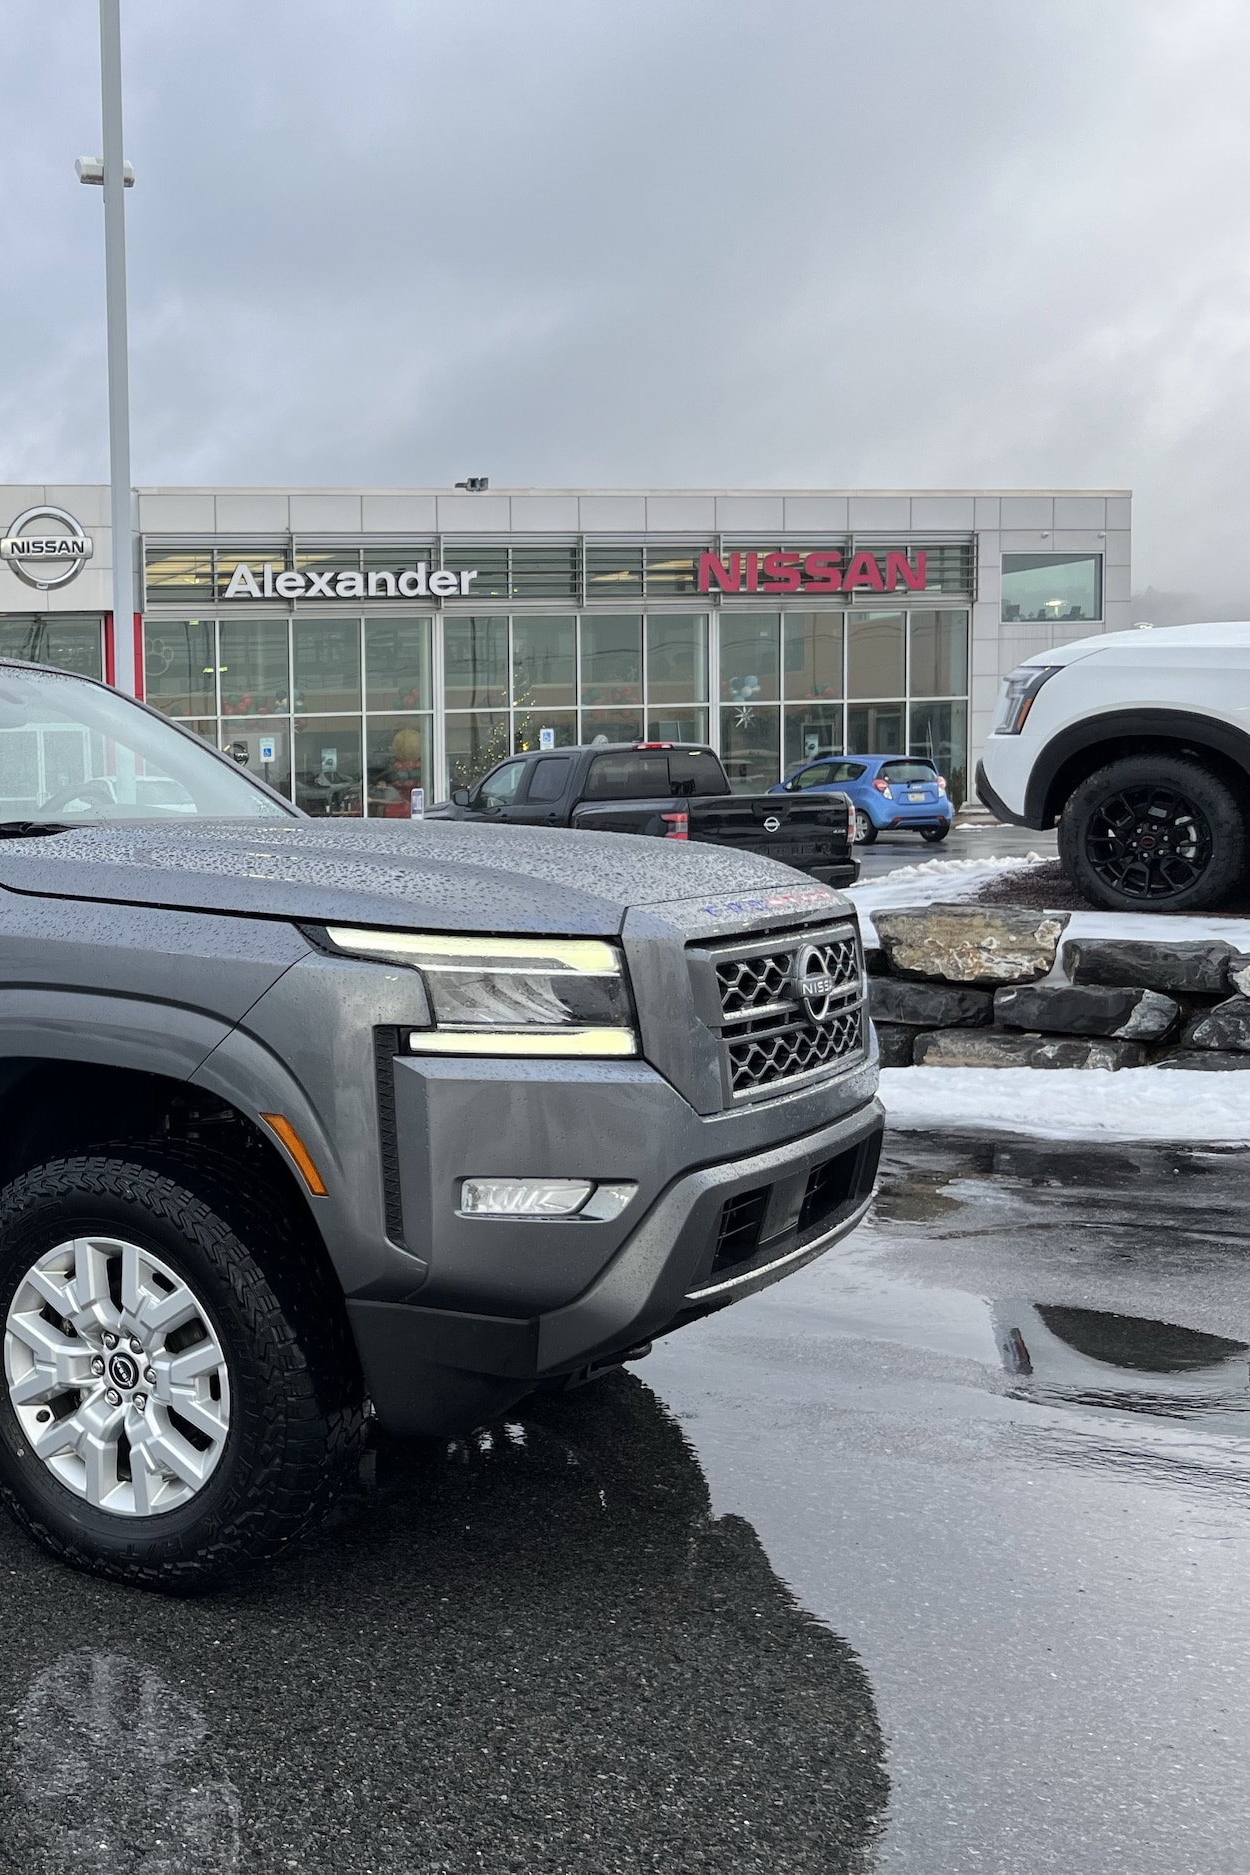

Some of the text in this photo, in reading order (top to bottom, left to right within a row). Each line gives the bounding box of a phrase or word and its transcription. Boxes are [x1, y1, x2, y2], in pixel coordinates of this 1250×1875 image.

[10, 541, 84, 554] NISSAN
[224, 562, 478, 599] Alexander
[698, 551, 927, 593] NISSAN
[802, 980, 832, 995] NISS
